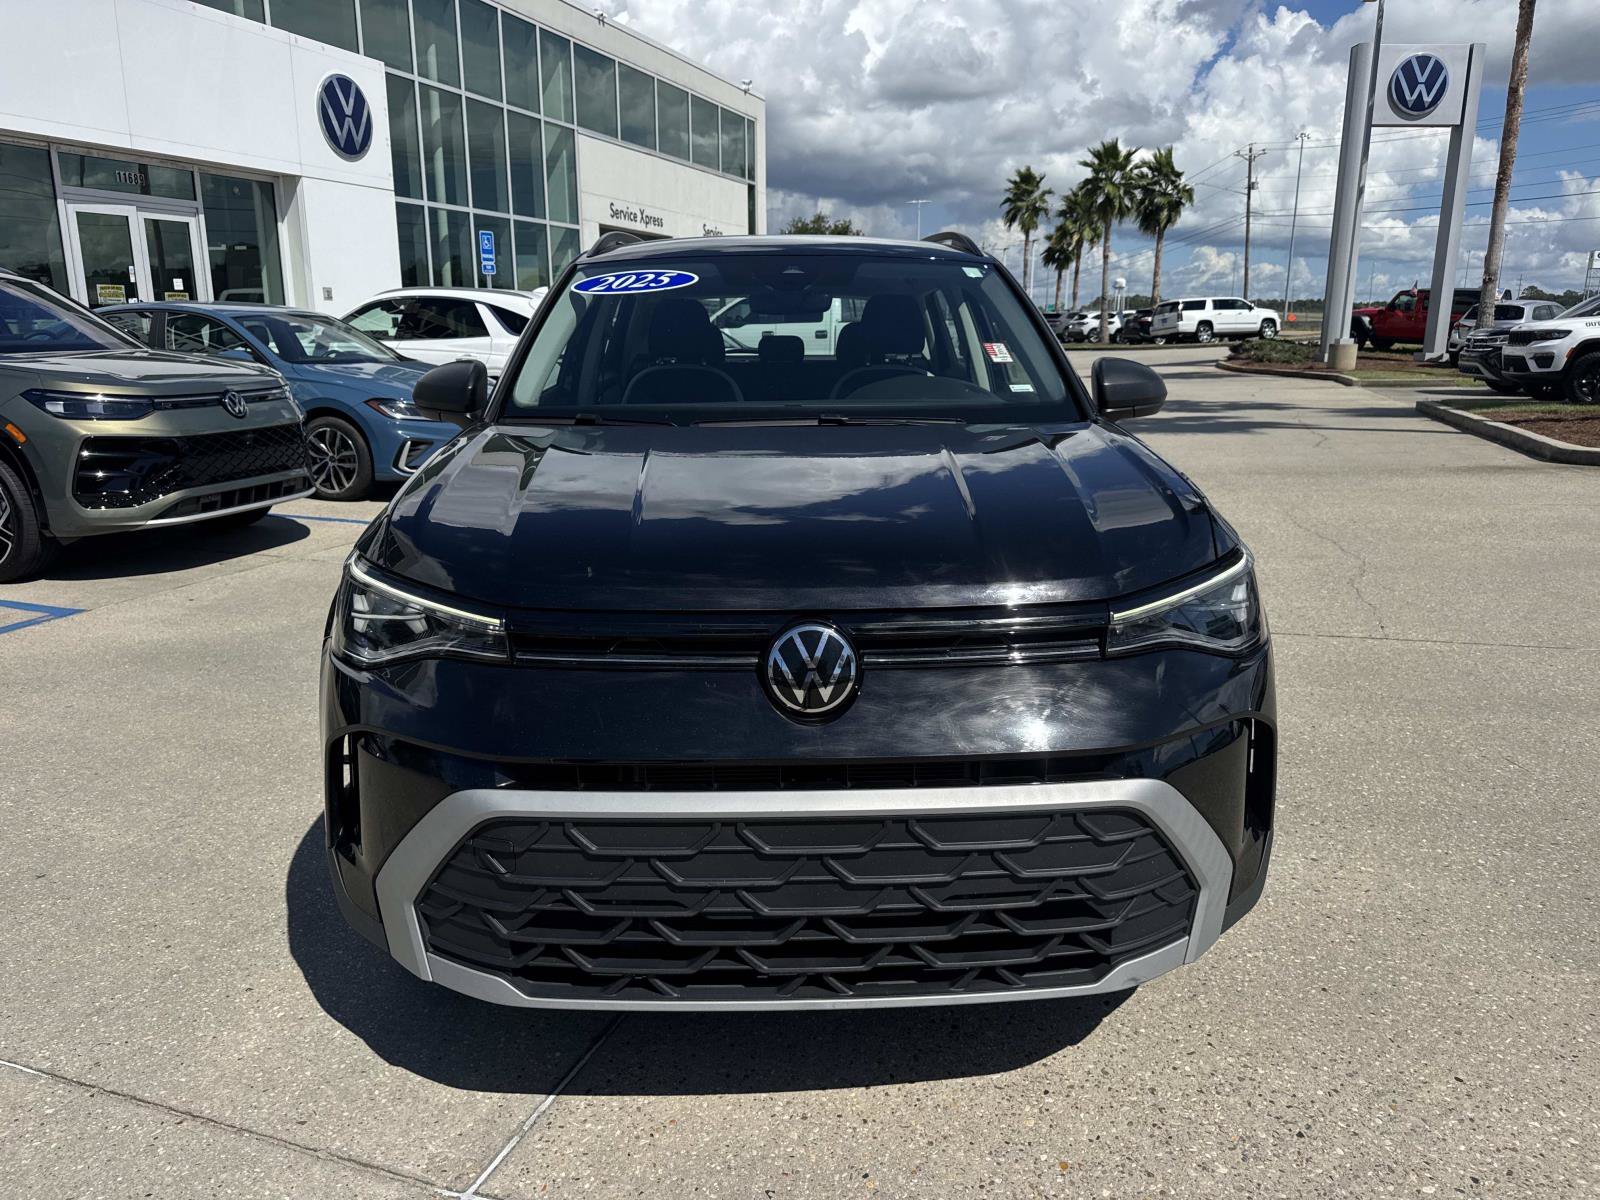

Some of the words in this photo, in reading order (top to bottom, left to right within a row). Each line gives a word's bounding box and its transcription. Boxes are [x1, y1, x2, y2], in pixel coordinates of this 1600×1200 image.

[1394, 55, 1448, 111] VW
[320, 76, 371, 155] VW
[609, 202, 638, 222] Service
[640, 208, 664, 228] Xpress
[588, 273, 677, 292] 2025
[770, 627, 853, 707] VW
